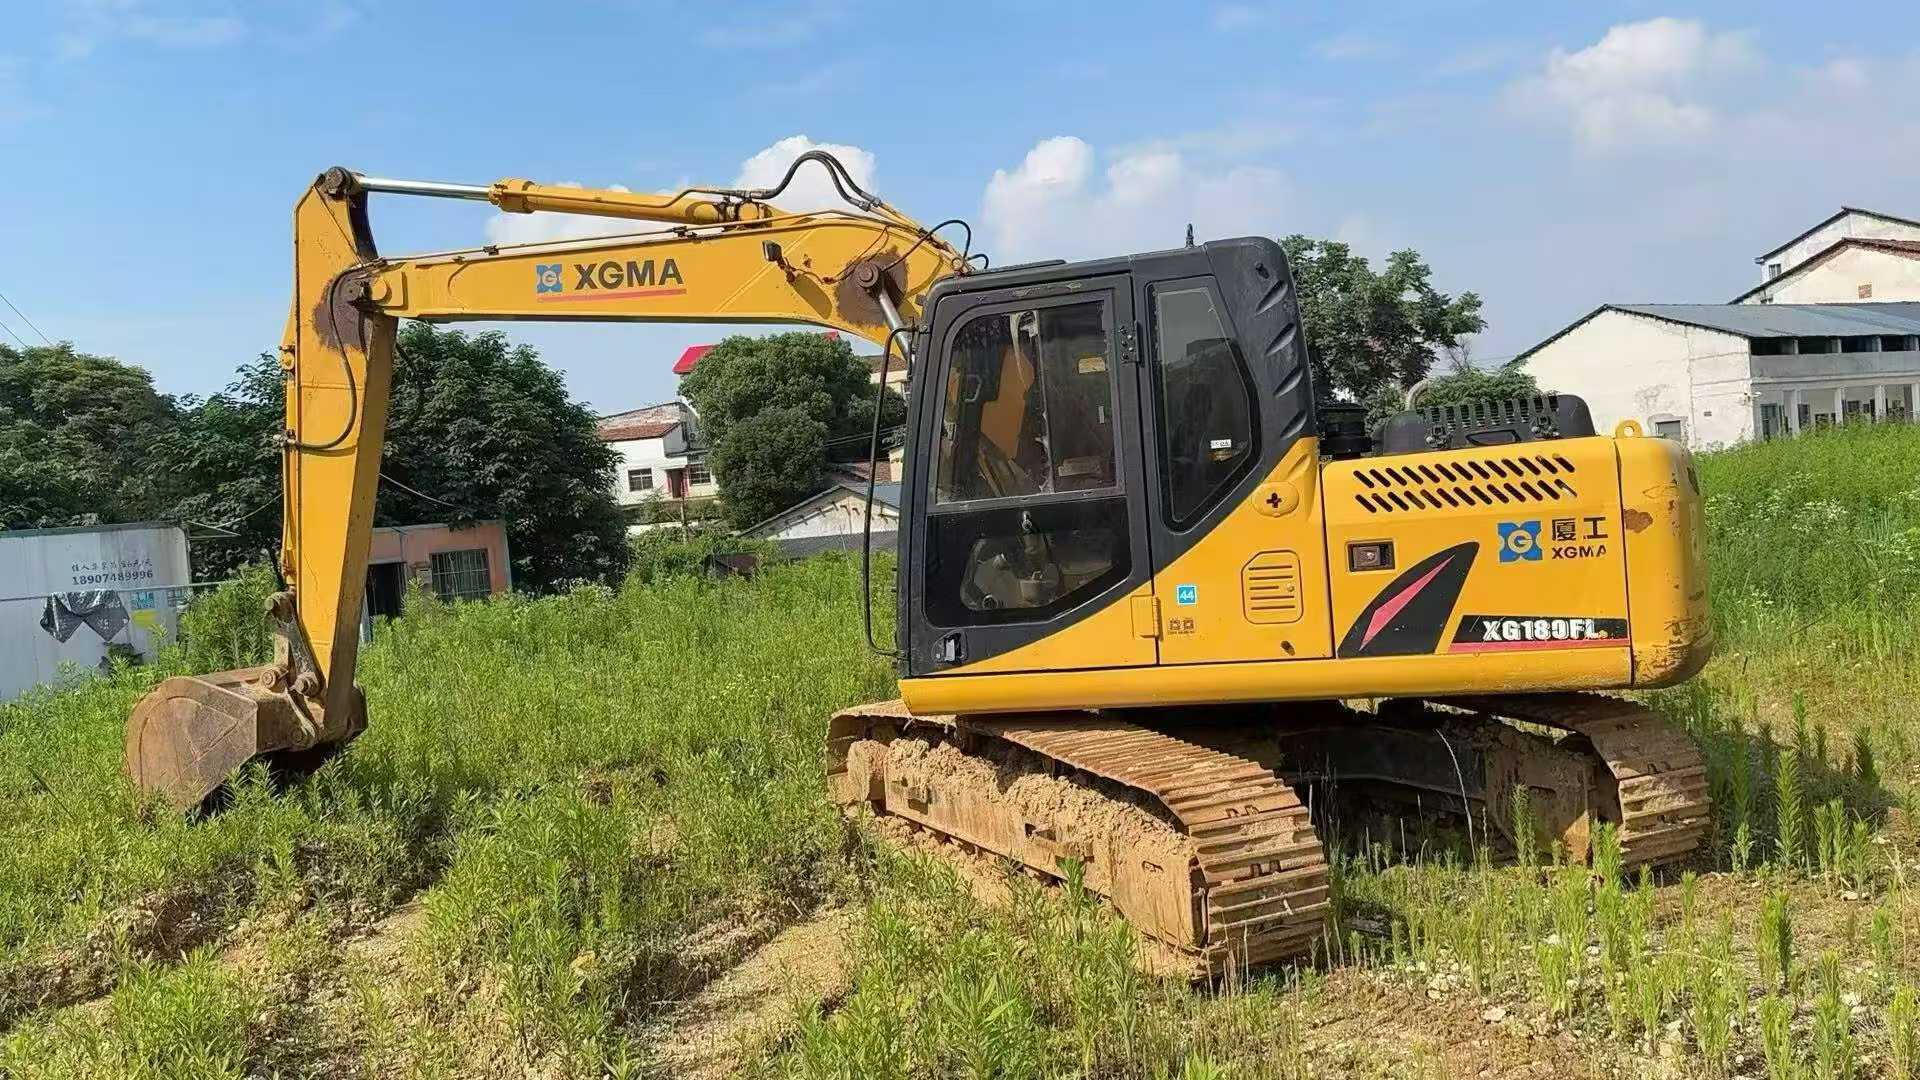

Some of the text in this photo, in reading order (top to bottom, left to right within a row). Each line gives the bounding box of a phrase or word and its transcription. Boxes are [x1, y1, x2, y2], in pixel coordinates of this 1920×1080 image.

[573, 258, 684, 291] XGMA
[1551, 516, 1609, 542] 厦工
[1551, 544, 1607, 560] XGMA
[1179, 589, 1195, 601] 44
